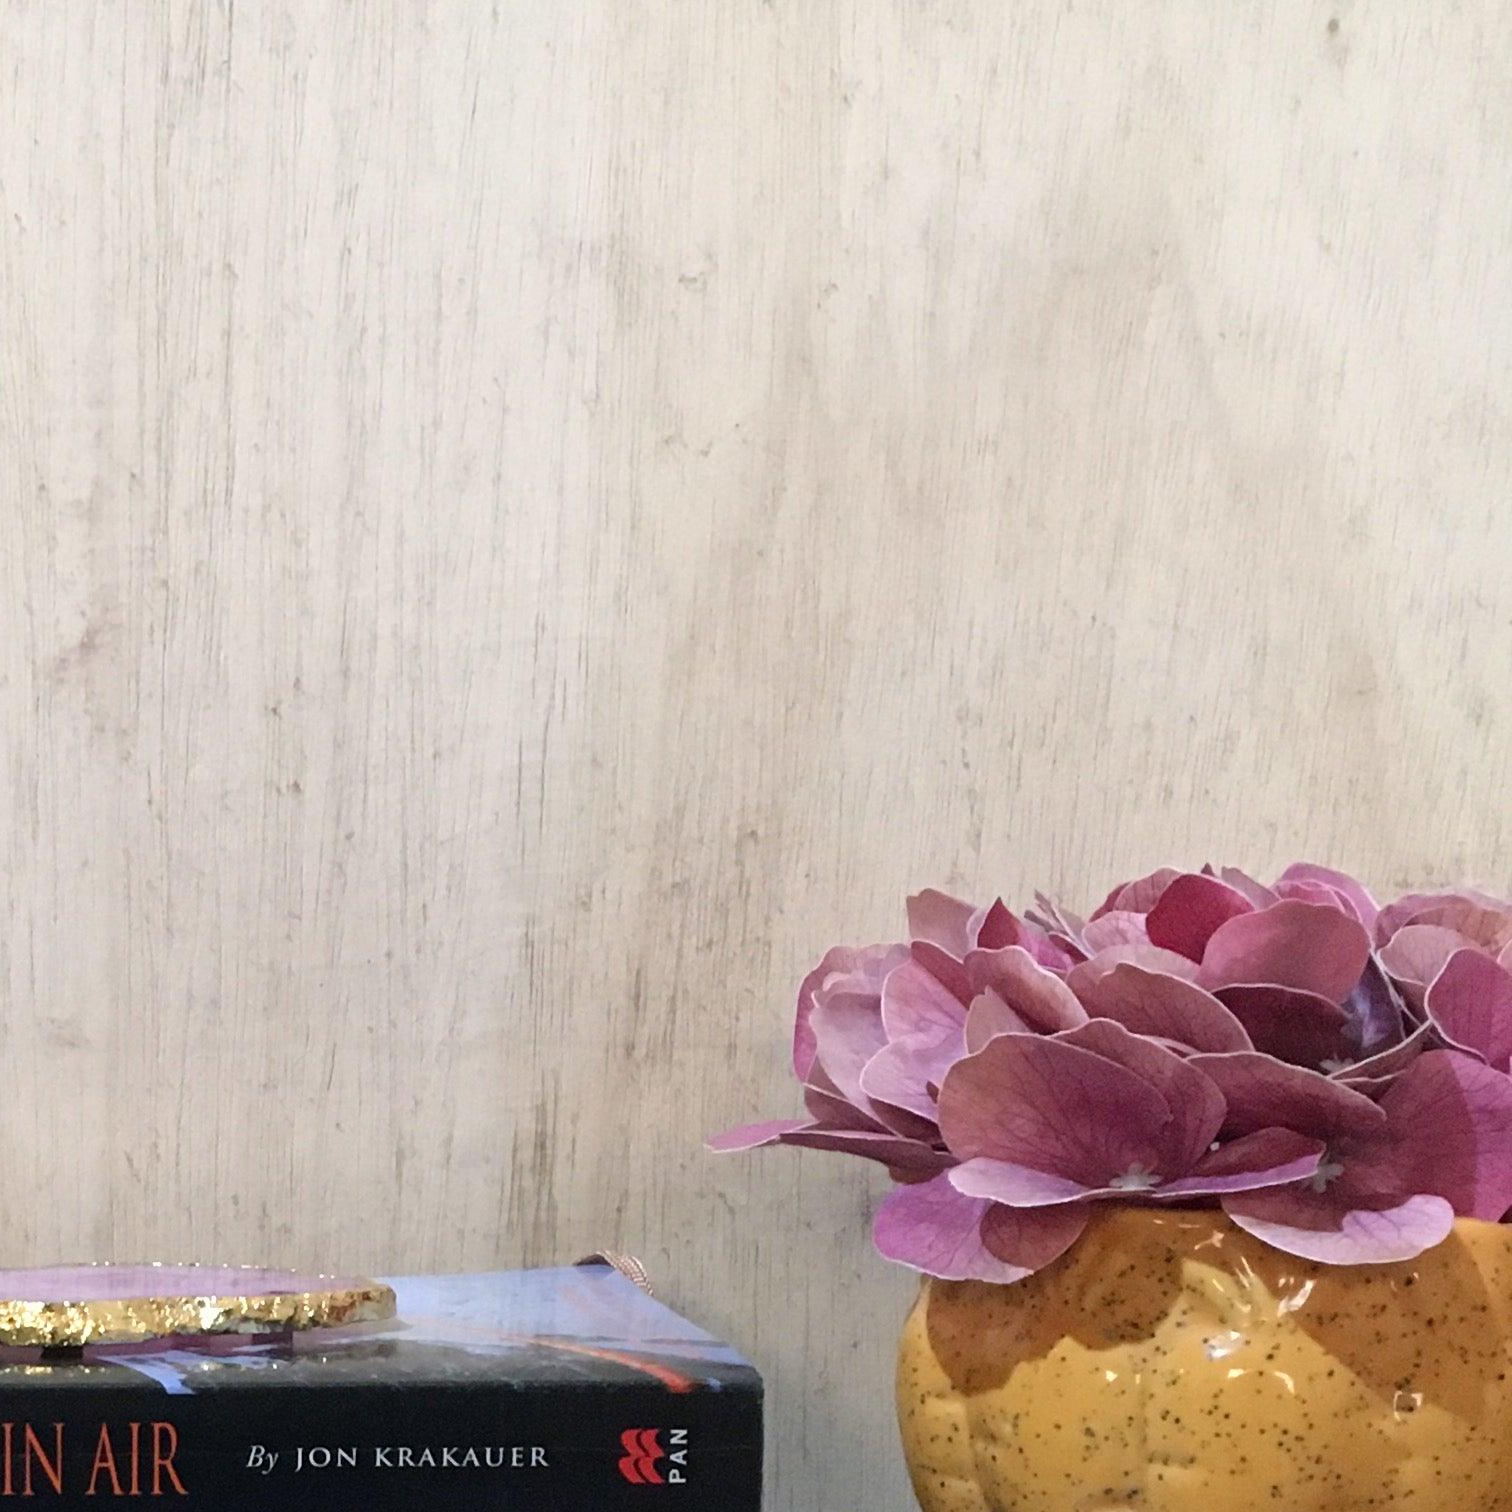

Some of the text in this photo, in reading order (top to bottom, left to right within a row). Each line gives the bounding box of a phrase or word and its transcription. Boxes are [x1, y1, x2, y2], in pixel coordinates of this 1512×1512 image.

[85, 1421, 188, 1495] AIR
[246, 1445, 549, 1475] By JON KRAKAUER
[669, 1429, 688, 1483] PAN
